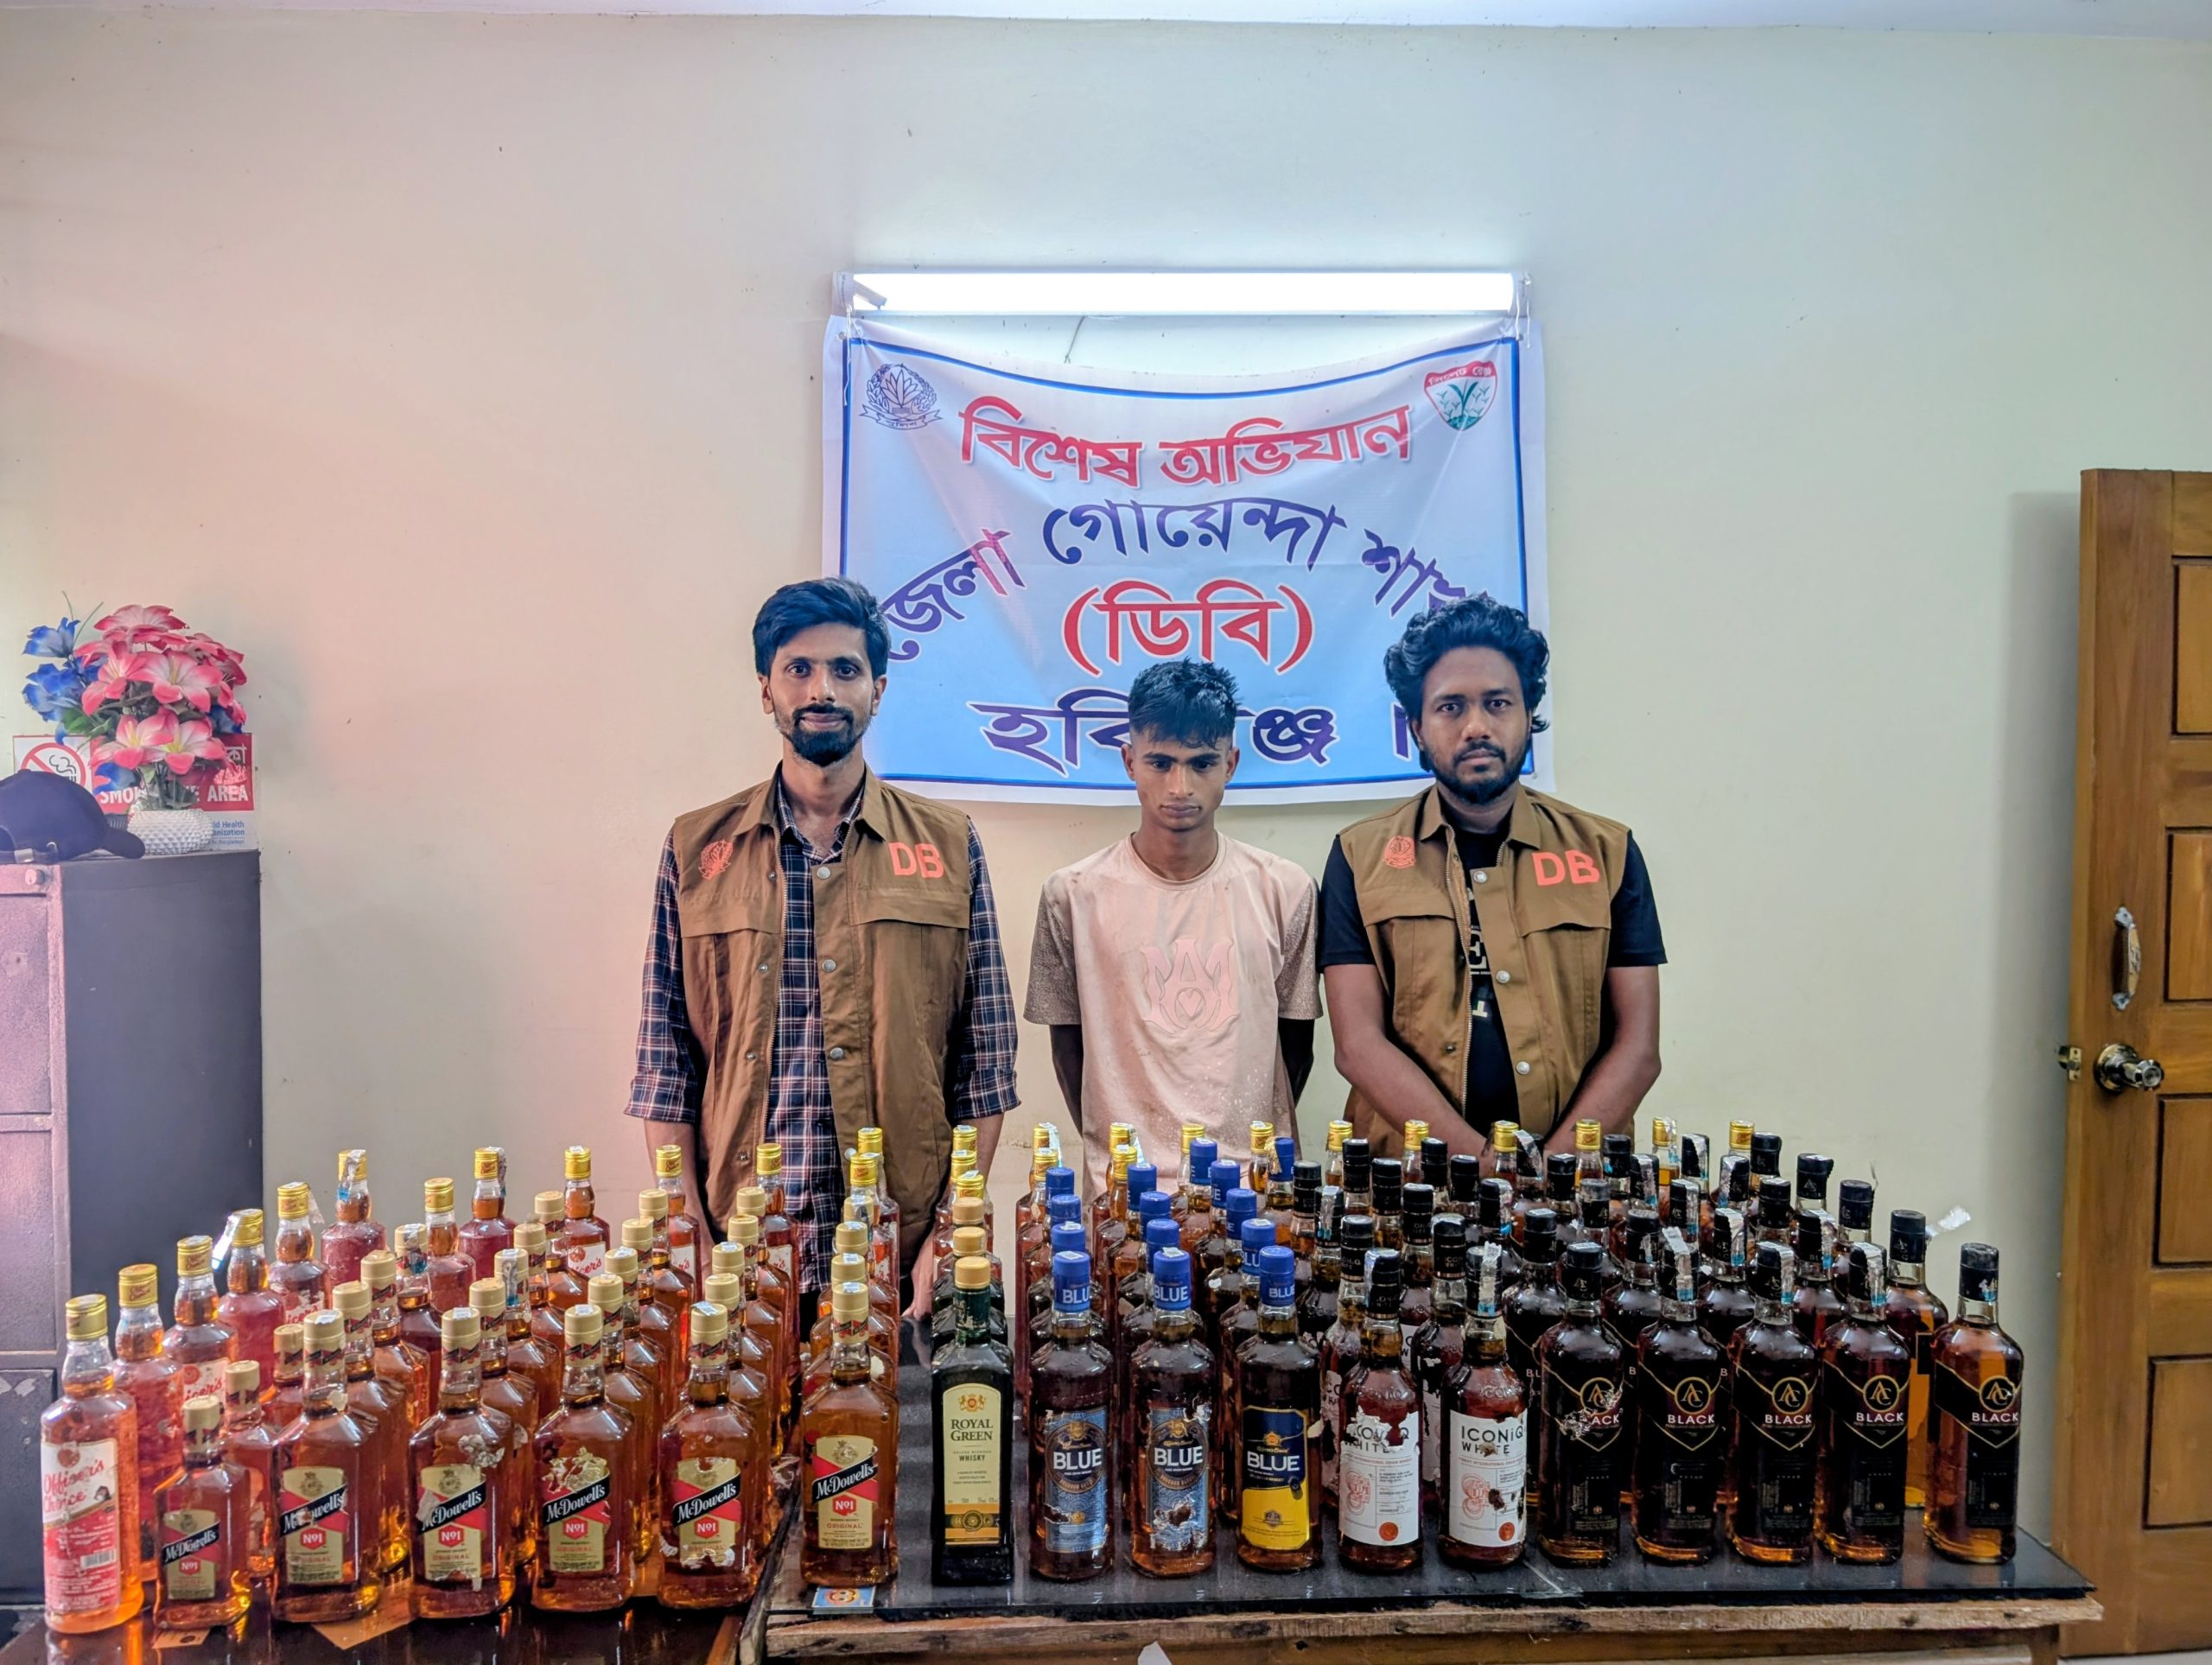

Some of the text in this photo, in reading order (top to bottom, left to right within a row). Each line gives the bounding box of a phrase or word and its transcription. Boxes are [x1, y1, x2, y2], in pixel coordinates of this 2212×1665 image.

[957, 395, 1410, 487] বিশেষ অভিযান
[1042, 498, 1348, 572] গোয়েন্দা
[1362, 529, 1488, 617] শা
[1064, 579, 1313, 676] (ডিবি)
[967, 689, 1338, 776] হবিঞ্জ
[100, 787, 141, 804] SMO
[207, 785, 249, 802] AREA
[888, 842, 944, 879] DB
[1531, 849, 1600, 887] DB
[1242, 1252, 1260, 1267] LU
[1063, 1287, 1090, 1304] BLU
[1154, 1285, 1188, 1302] BLUE
[1681, 1383, 1704, 1408] AC
[1777, 1383, 1801, 1408] AC
[1870, 1382, 1892, 1405] AC
[950, 1419, 993, 1430] ROYAL
[1592, 1414, 1620, 1425] ACK
[1668, 1414, 1715, 1424] BLACK
[1765, 1414, 1812, 1424] BLACK
[1856, 1412, 1904, 1422] BLACK
[1972, 1412, 2018, 1422] BLACK
[950, 1430, 993, 1441] GREEN
[1154, 1446, 1203, 1466] BLUE
[1462, 1441, 1510, 1455] WHE
[1053, 1447, 1103, 1470] BLUE
[1247, 1452, 1300, 1471] BLUE
[546, 1484, 606, 1522] McDowell's
[677, 1484, 737, 1523] McDowell's
